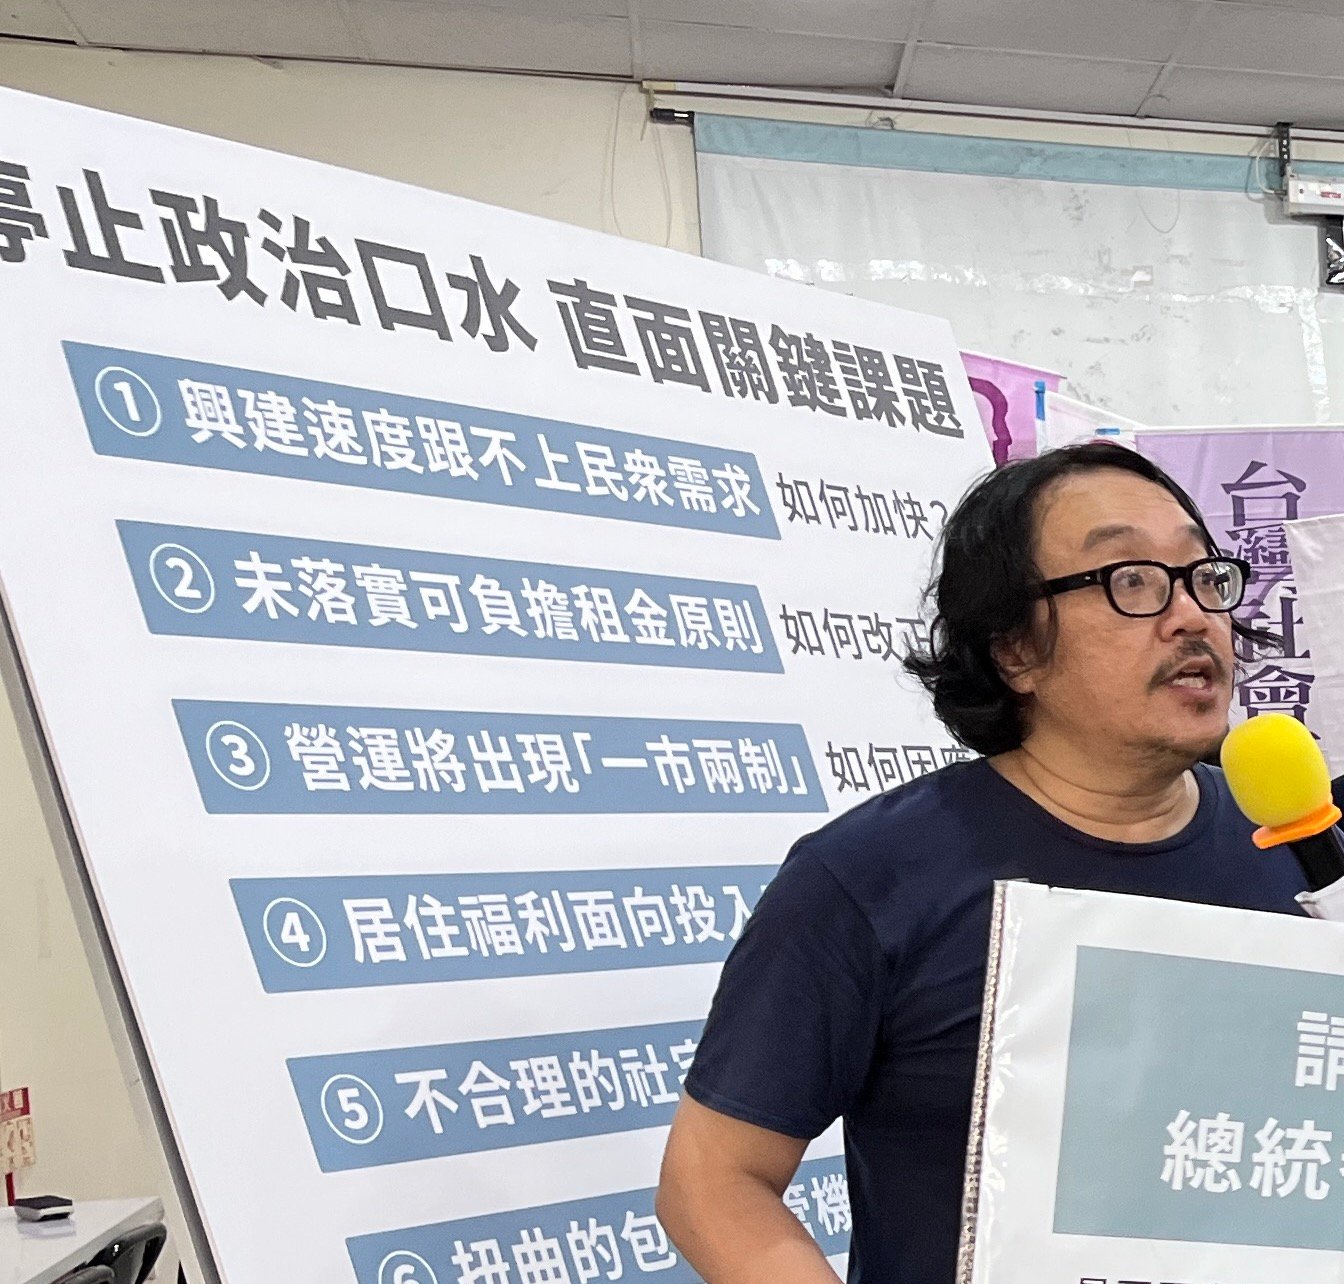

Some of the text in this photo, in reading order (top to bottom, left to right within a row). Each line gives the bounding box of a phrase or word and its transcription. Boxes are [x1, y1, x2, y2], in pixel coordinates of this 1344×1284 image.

[546, 278, 965, 439] 直面關鍵課題
[233, 551, 765, 654] 未落實可負擔租金原則
[342, 883, 767, 964] 居住福利面向投入
